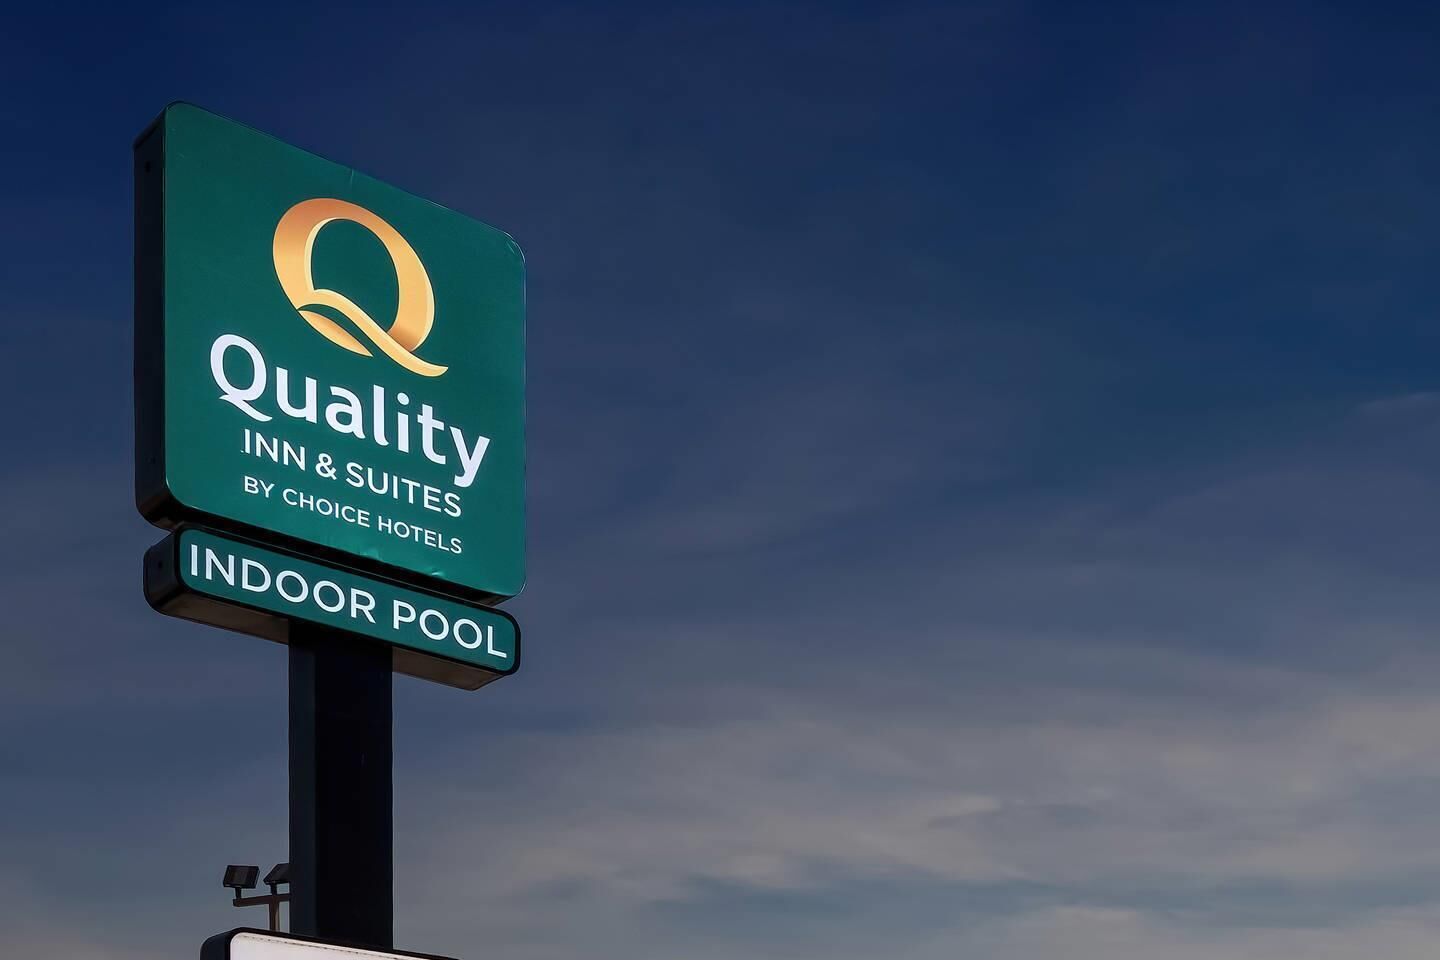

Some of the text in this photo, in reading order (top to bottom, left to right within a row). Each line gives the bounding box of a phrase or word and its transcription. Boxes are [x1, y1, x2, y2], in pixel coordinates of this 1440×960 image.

[209, 333, 491, 488] Quality
[243, 428, 463, 519] INN & SUITES
[243, 475, 463, 556] BY CHOICE HOTELS
[190, 544, 508, 660] INDOOR POOL
